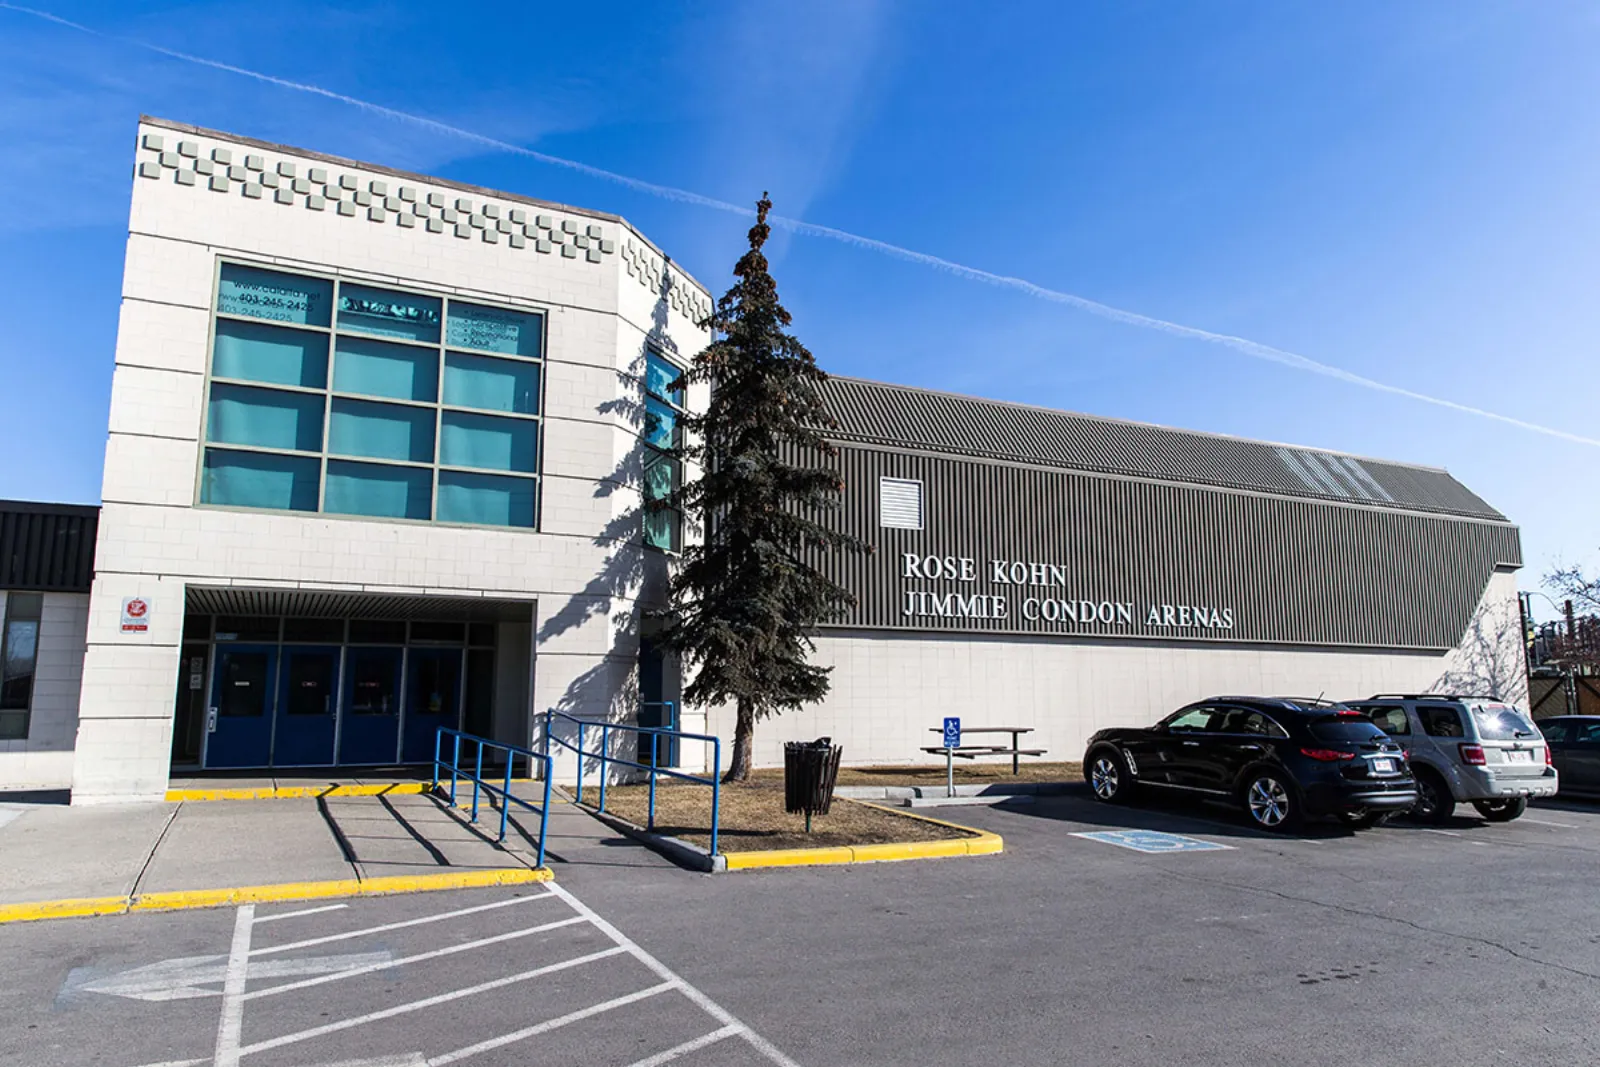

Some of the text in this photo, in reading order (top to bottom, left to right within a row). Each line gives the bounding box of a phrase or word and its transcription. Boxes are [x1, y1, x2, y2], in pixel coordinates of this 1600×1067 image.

[239, 293, 313, 312] 403-245-2425
[902, 553, 1067, 587] ROSE KOHN
[904, 591, 1234, 629] JIMMIE CONDON ARENAS
